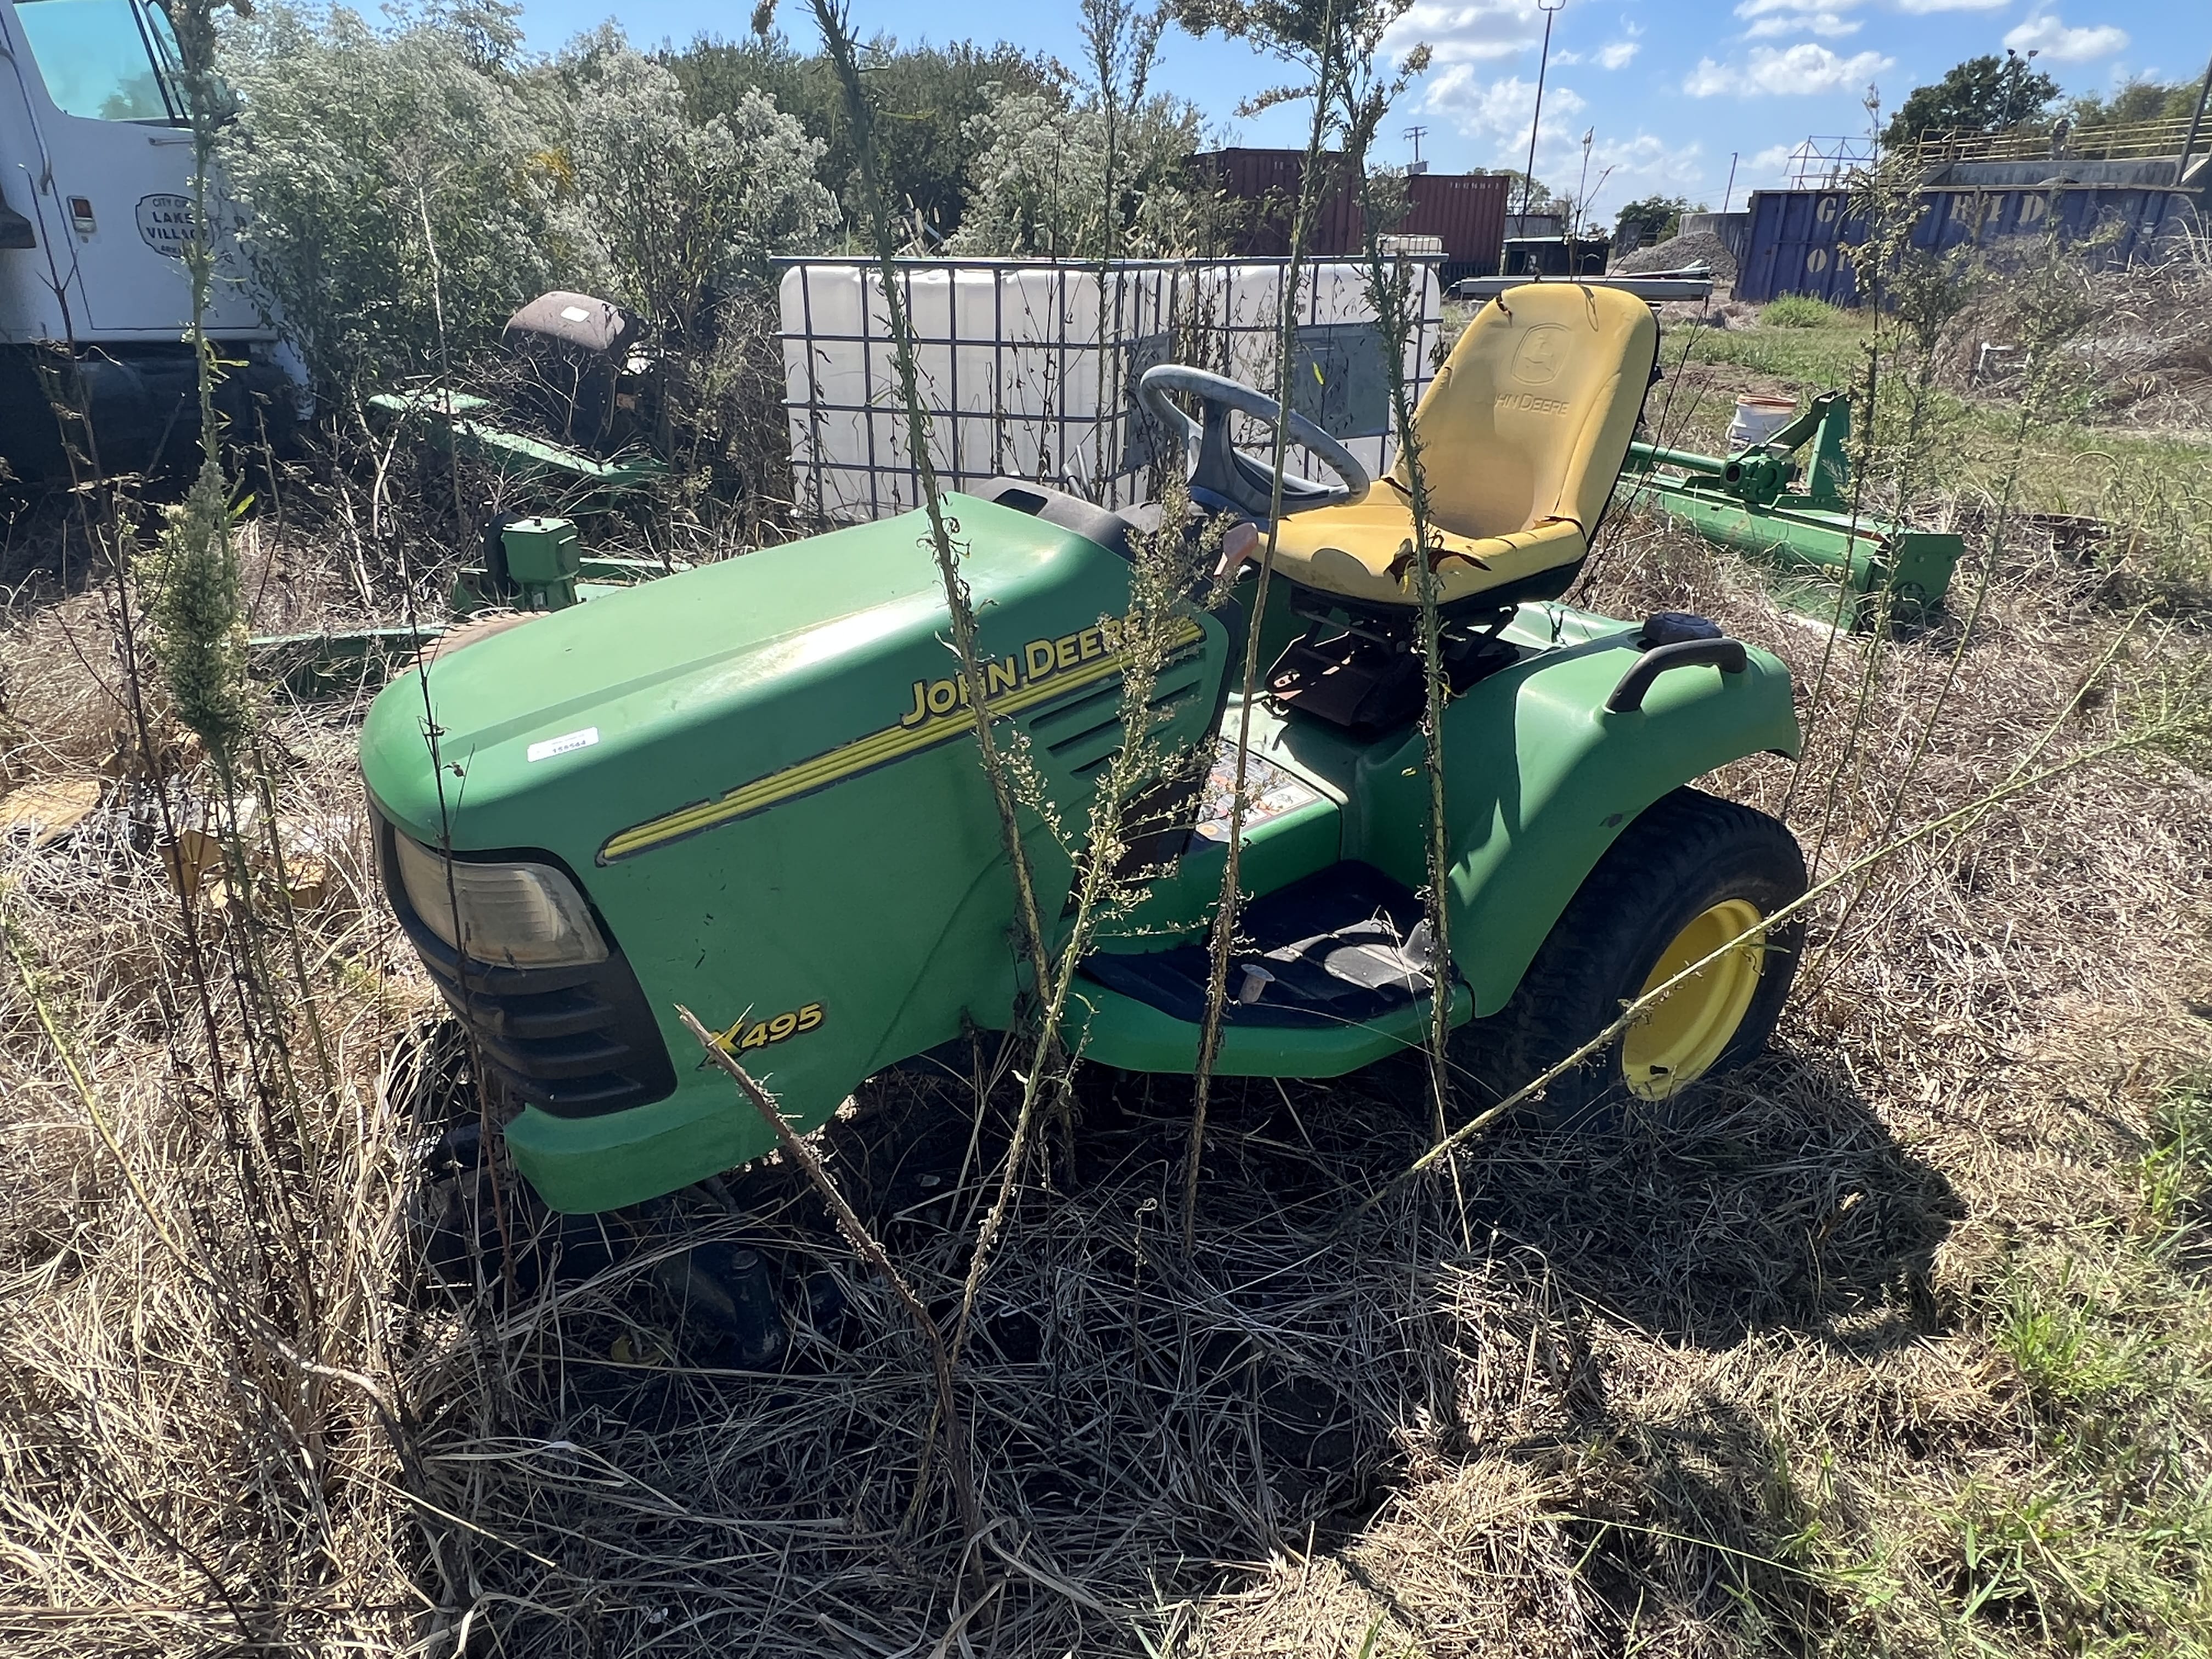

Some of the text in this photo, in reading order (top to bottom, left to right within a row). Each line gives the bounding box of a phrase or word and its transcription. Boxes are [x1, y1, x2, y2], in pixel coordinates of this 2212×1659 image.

[153, 198, 171, 207] CITY
[152, 211, 196, 224] LAKE
[1519, 393, 1571, 417] DEERE
[901, 609, 1145, 728] JOHN DEERE
